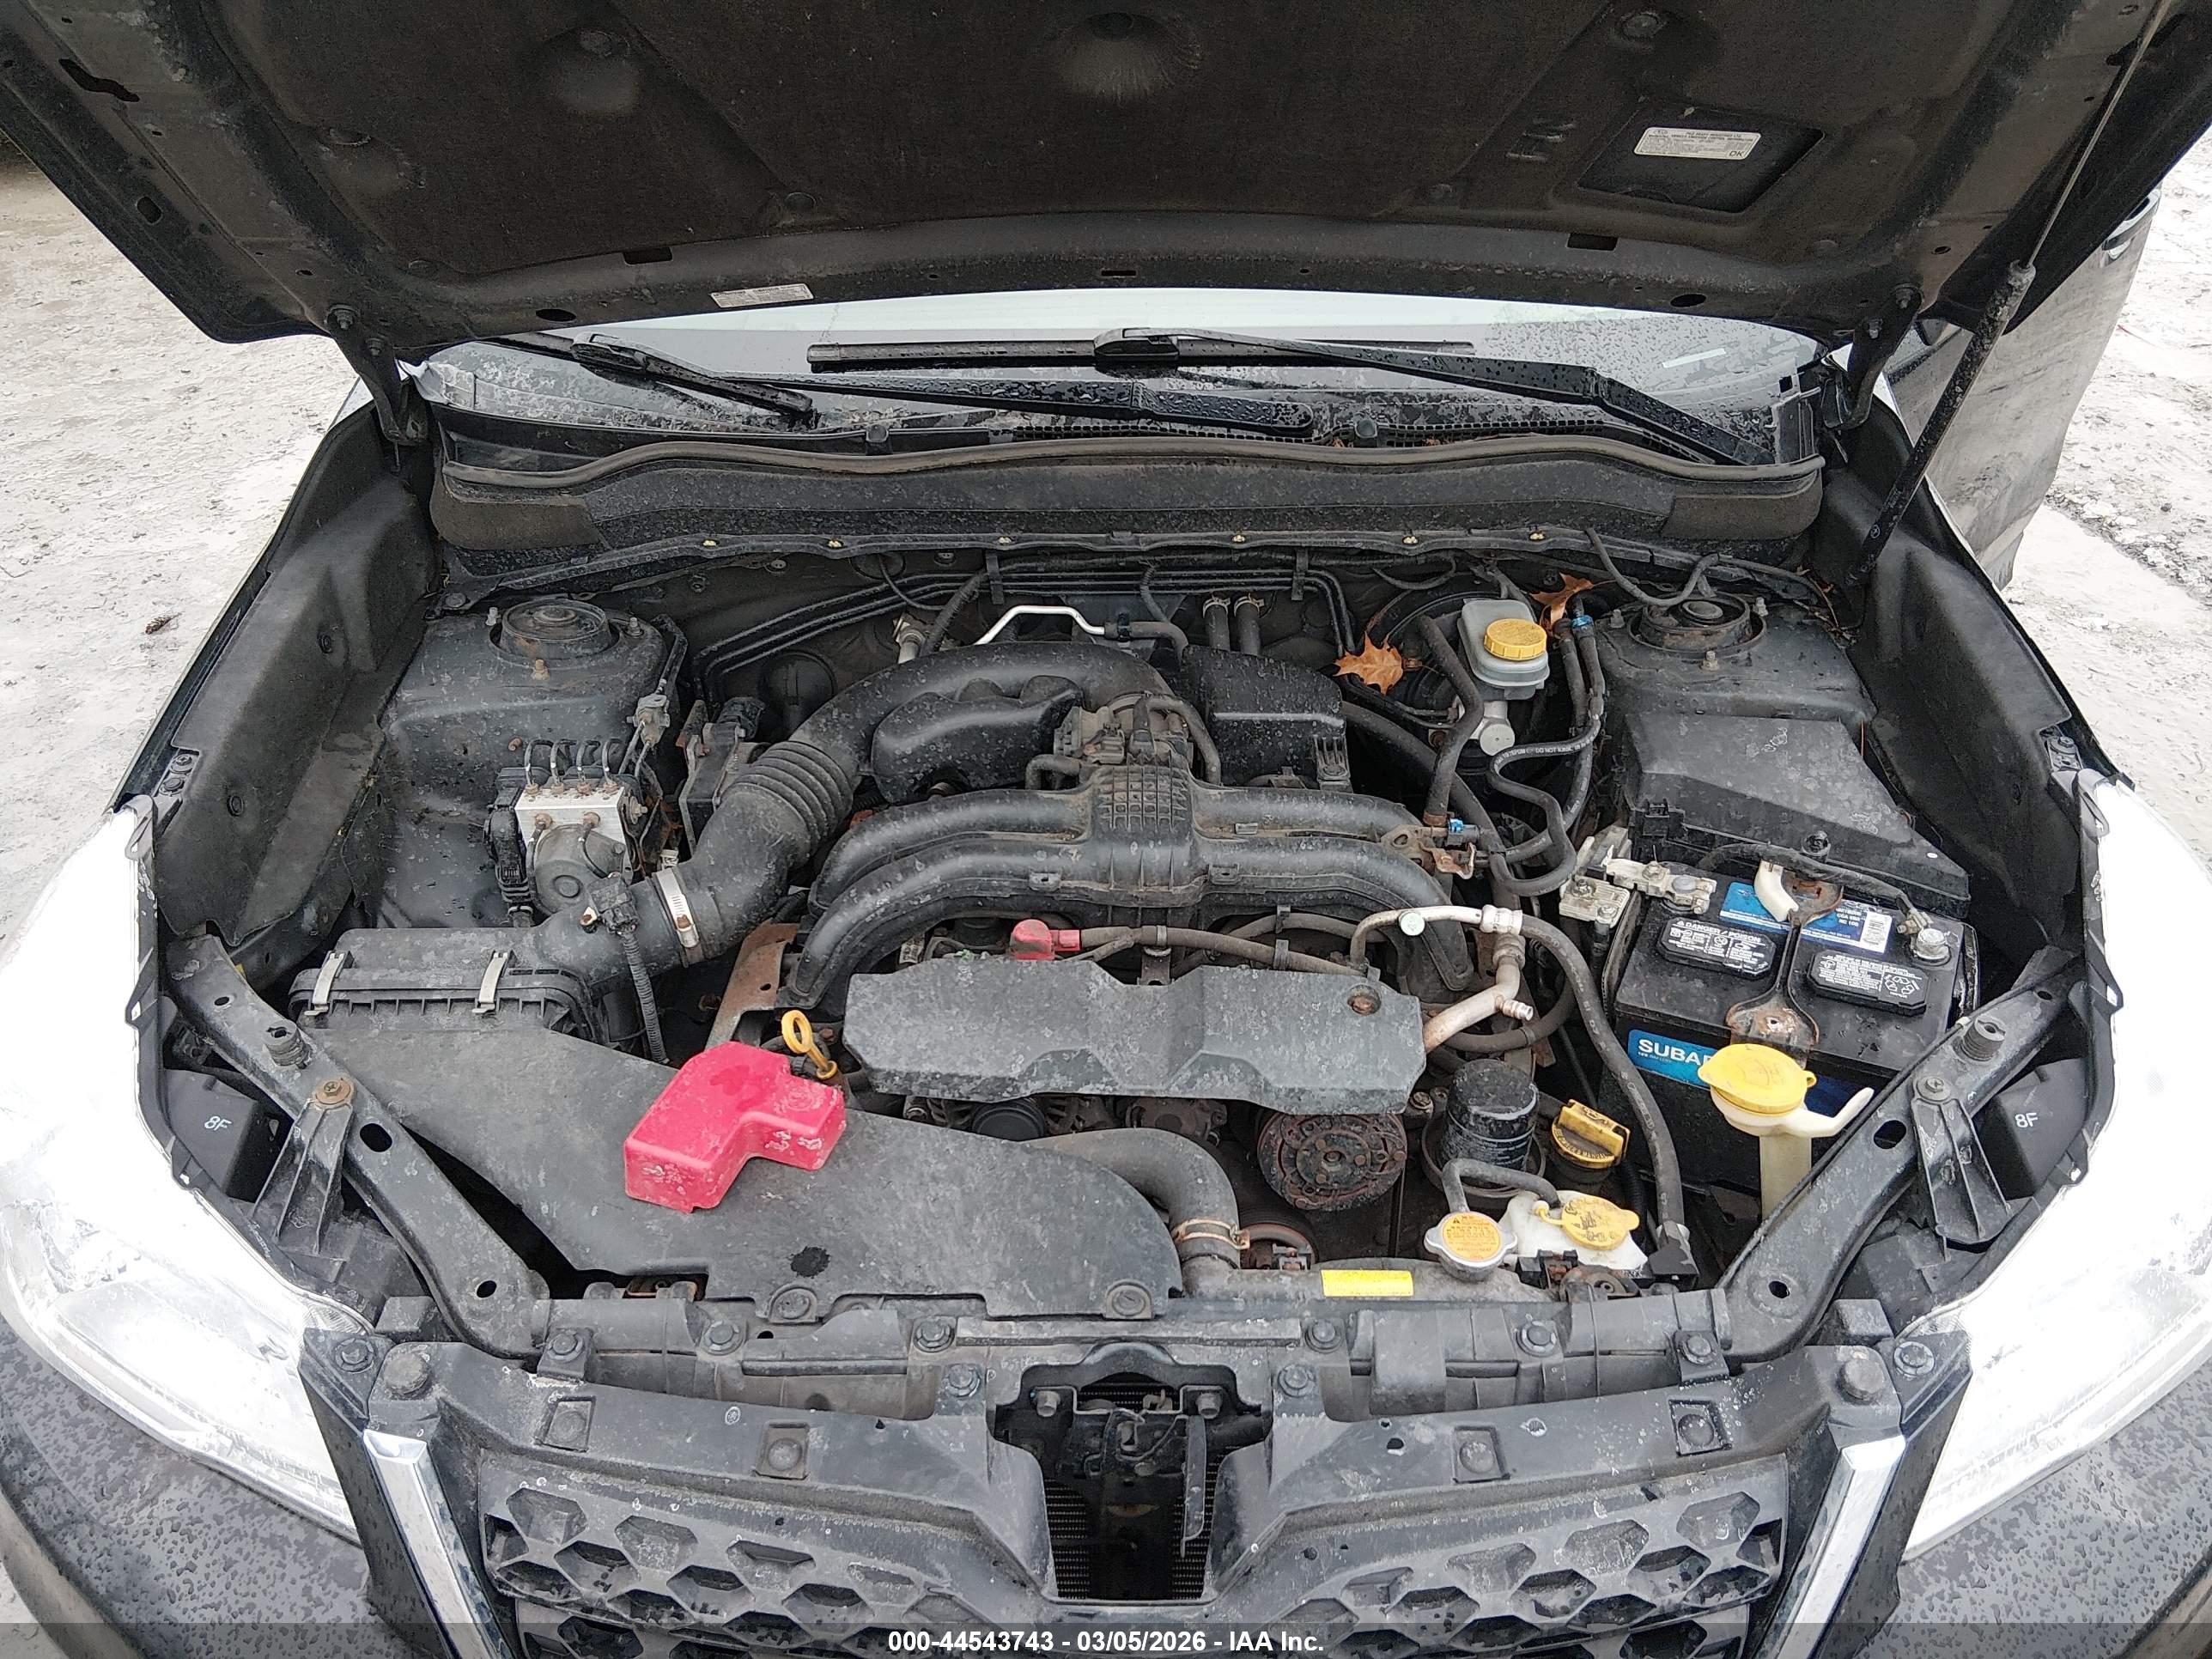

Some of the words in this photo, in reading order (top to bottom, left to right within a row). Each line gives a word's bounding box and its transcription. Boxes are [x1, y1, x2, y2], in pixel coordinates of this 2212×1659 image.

[1685, 921, 1721, 935] DANGER
[1728, 931, 1761, 943] POISON
[204, 1115, 232, 1131] 8F
[2014, 1112, 2039, 1128] 8F
